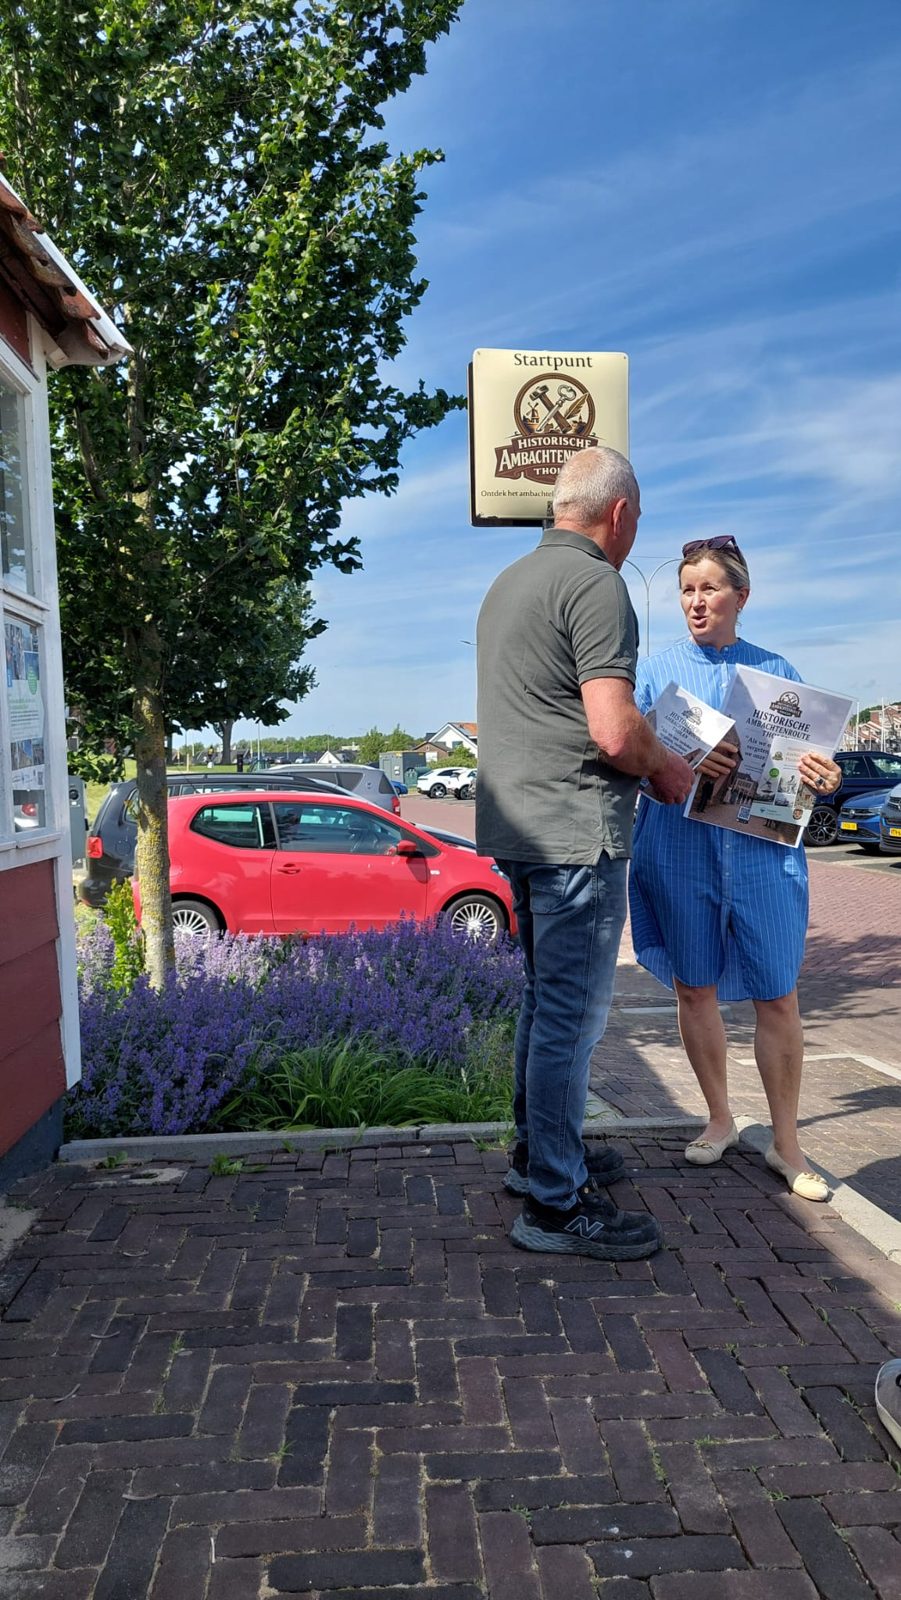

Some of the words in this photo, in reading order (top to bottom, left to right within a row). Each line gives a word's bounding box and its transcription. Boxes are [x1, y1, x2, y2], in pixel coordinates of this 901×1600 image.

[514, 353, 593, 370] Startpunt
[518, 437, 592, 449] HISTORISCHE
[499, 449, 577, 471] AMBACHTEN
[533, 467, 559, 475] THO
[746, 717, 811, 740] AMBACHTENROUTE
[752, 709, 811, 732] HISTORISCHE
